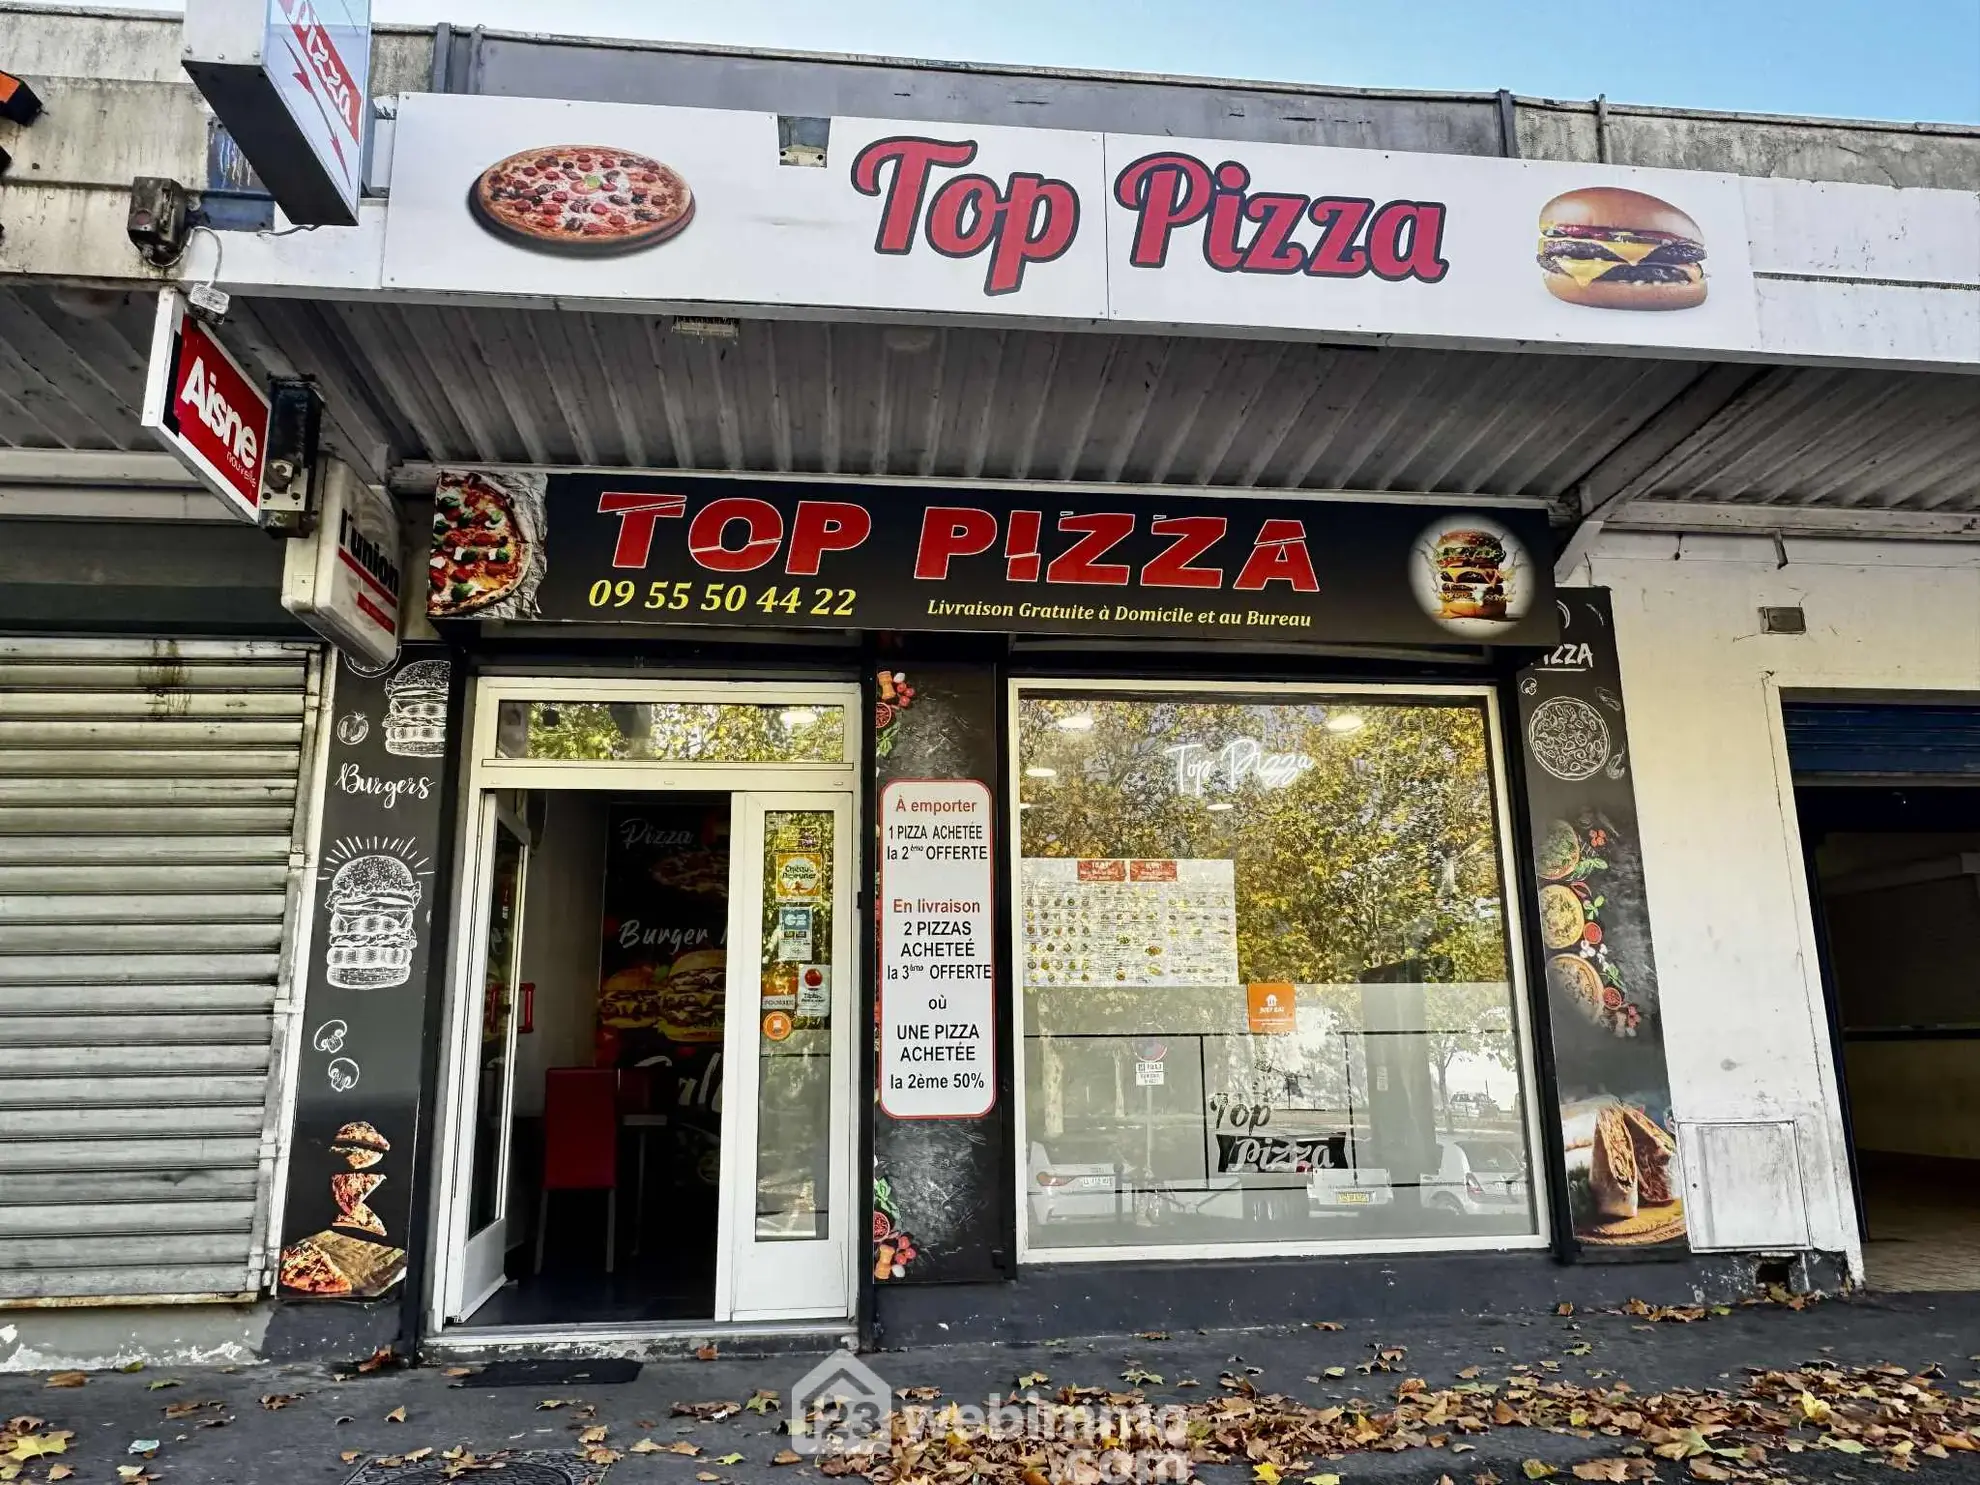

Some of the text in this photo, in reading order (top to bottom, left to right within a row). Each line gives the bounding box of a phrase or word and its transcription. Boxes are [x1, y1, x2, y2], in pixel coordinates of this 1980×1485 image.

[850, 136, 1450, 296] Top Pizza
[180, 356, 258, 468] Aisne
[226, 450, 257, 488] nouvelle
[597, 491, 1320, 593] TOP PIZZA
[588, 579, 857, 617] 09 55 50 44 22
[927, 598, 1311, 627] Livraison Gratuite à Domicile et au Bureau
[1541, 643, 1594, 668] IZZA
[1165, 738, 1316, 796] Top Pizza
[334, 762, 436, 809] Burgers
[895, 794, 978, 816] À emporter
[620, 818, 694, 850] Pizza
[889, 821, 983, 840] 1 PIZZA ACHETÉE
[887, 845, 898, 860] la
[926, 845, 988, 861] OFFERTE
[893, 898, 981, 914] En livraison
[618, 919, 709, 956] Burger
[904, 921, 972, 936] 2 PIZZAS
[900, 938, 976, 957] ACHETEÉ
[887, 965, 898, 980] la
[929, 964, 992, 980] OFFERTE
[928, 994, 947, 1010] où
[896, 1024, 980, 1040] UNE PIZZA
[900, 1042, 976, 1062] ACHETÉE
[890, 1072, 985, 1090] la 2ème 50%
[1209, 1092, 1271, 1136] Top
[1230, 1137, 1335, 1172] Pizza
